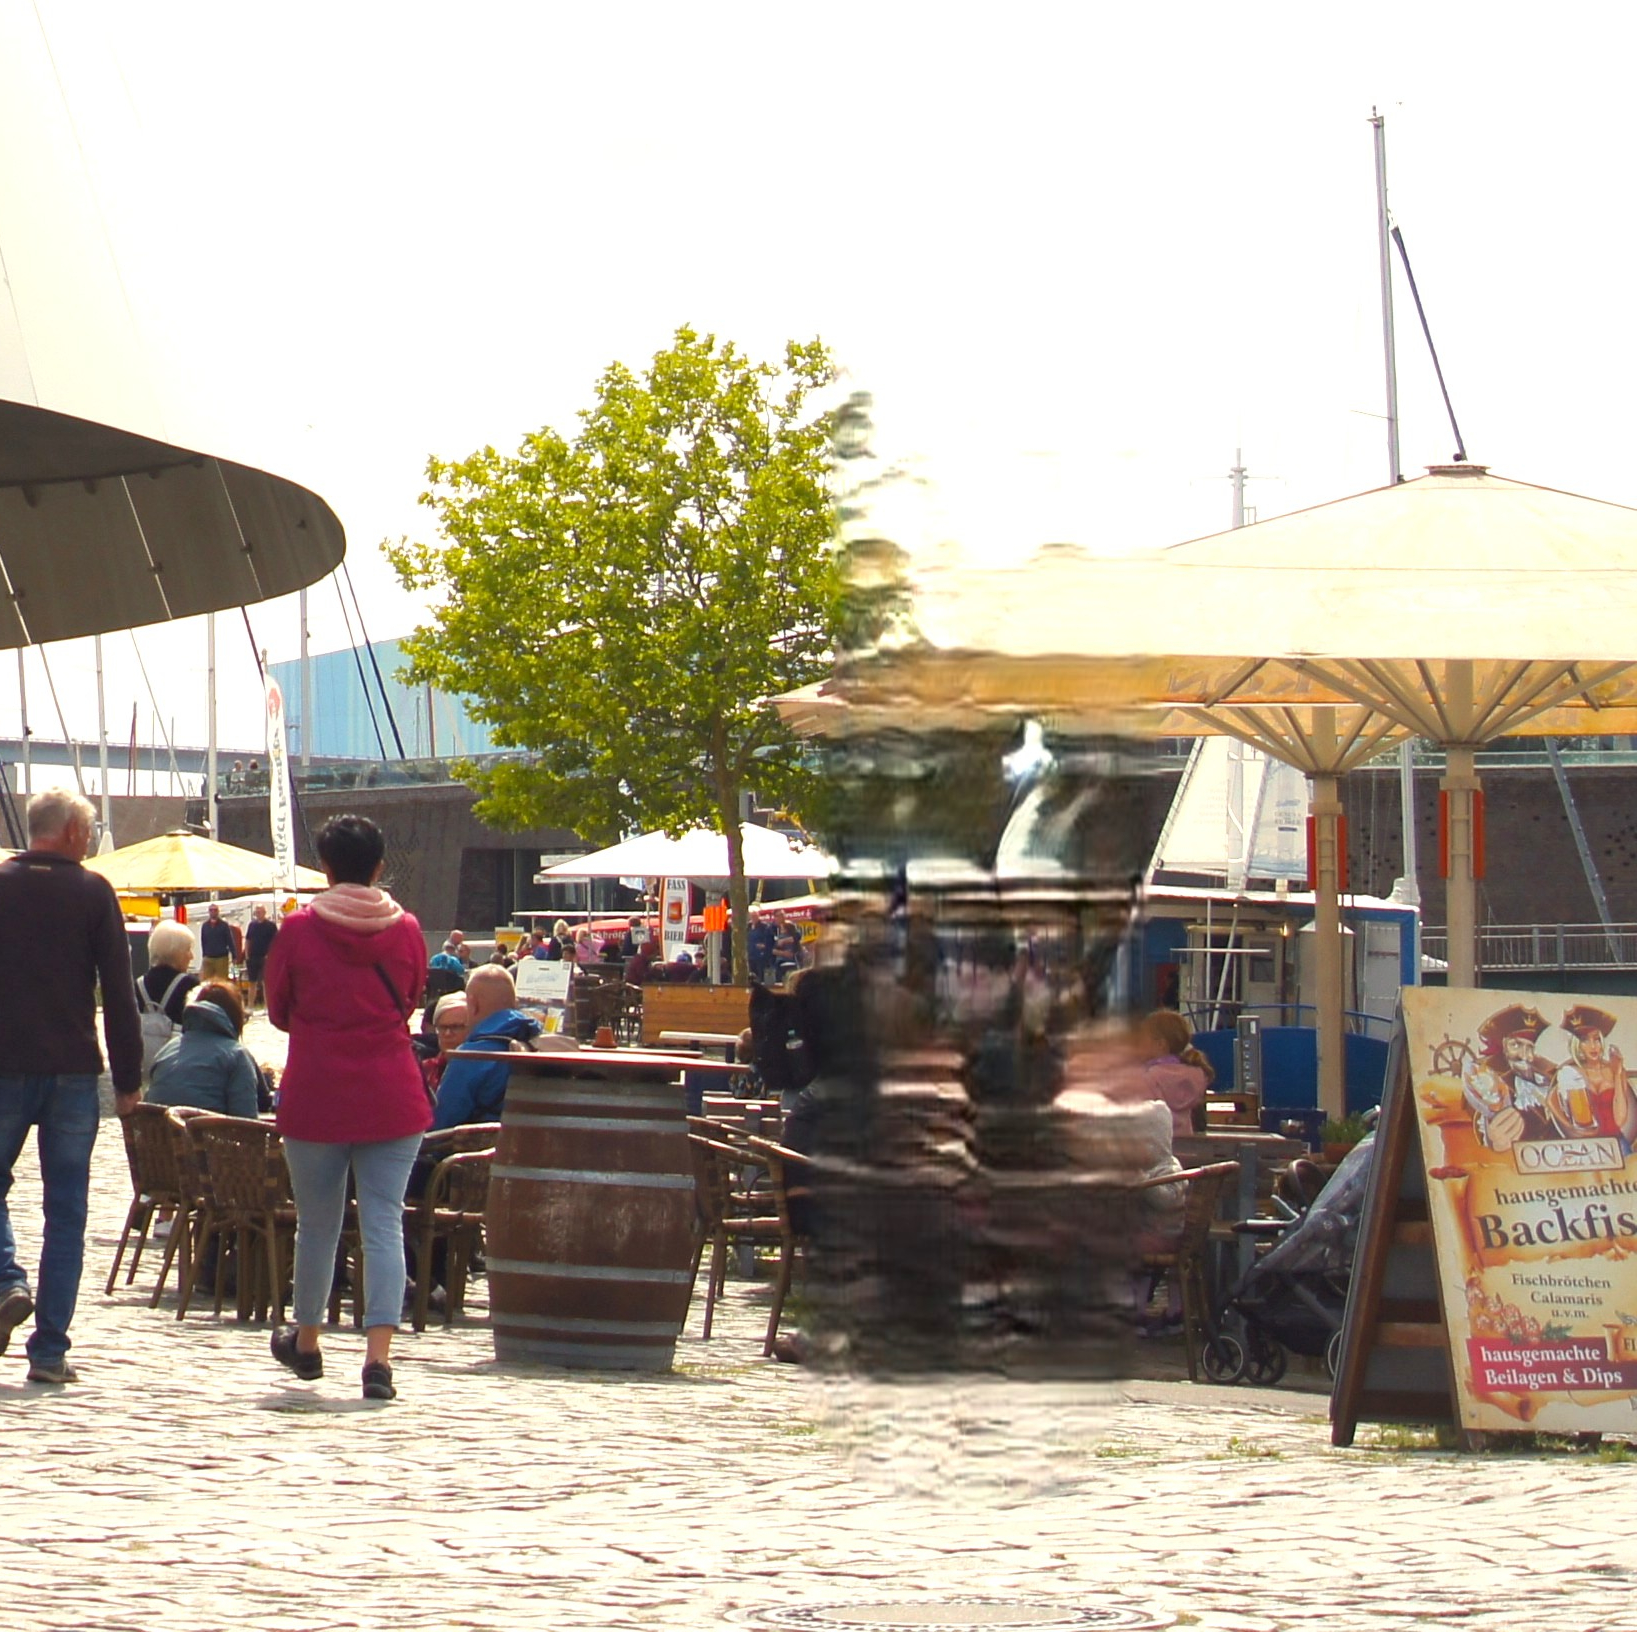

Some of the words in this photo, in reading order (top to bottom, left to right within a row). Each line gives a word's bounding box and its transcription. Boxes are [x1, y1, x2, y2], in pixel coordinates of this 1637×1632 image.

[667, 879, 686, 890] FASS
[664, 930, 684, 941] BIER
[1520, 1141, 1618, 1169] OCEAN
[1512, 1273, 1611, 1289] Fischbrötchen
[1530, 1291, 1603, 1306] Calamaris
[1480, 1344, 1601, 1367] hausgemachte
[1485, 1368, 1558, 1390] Beilagen
[1562, 1367, 1579, 1385] &
[1582, 1367, 1623, 1389] Dips
